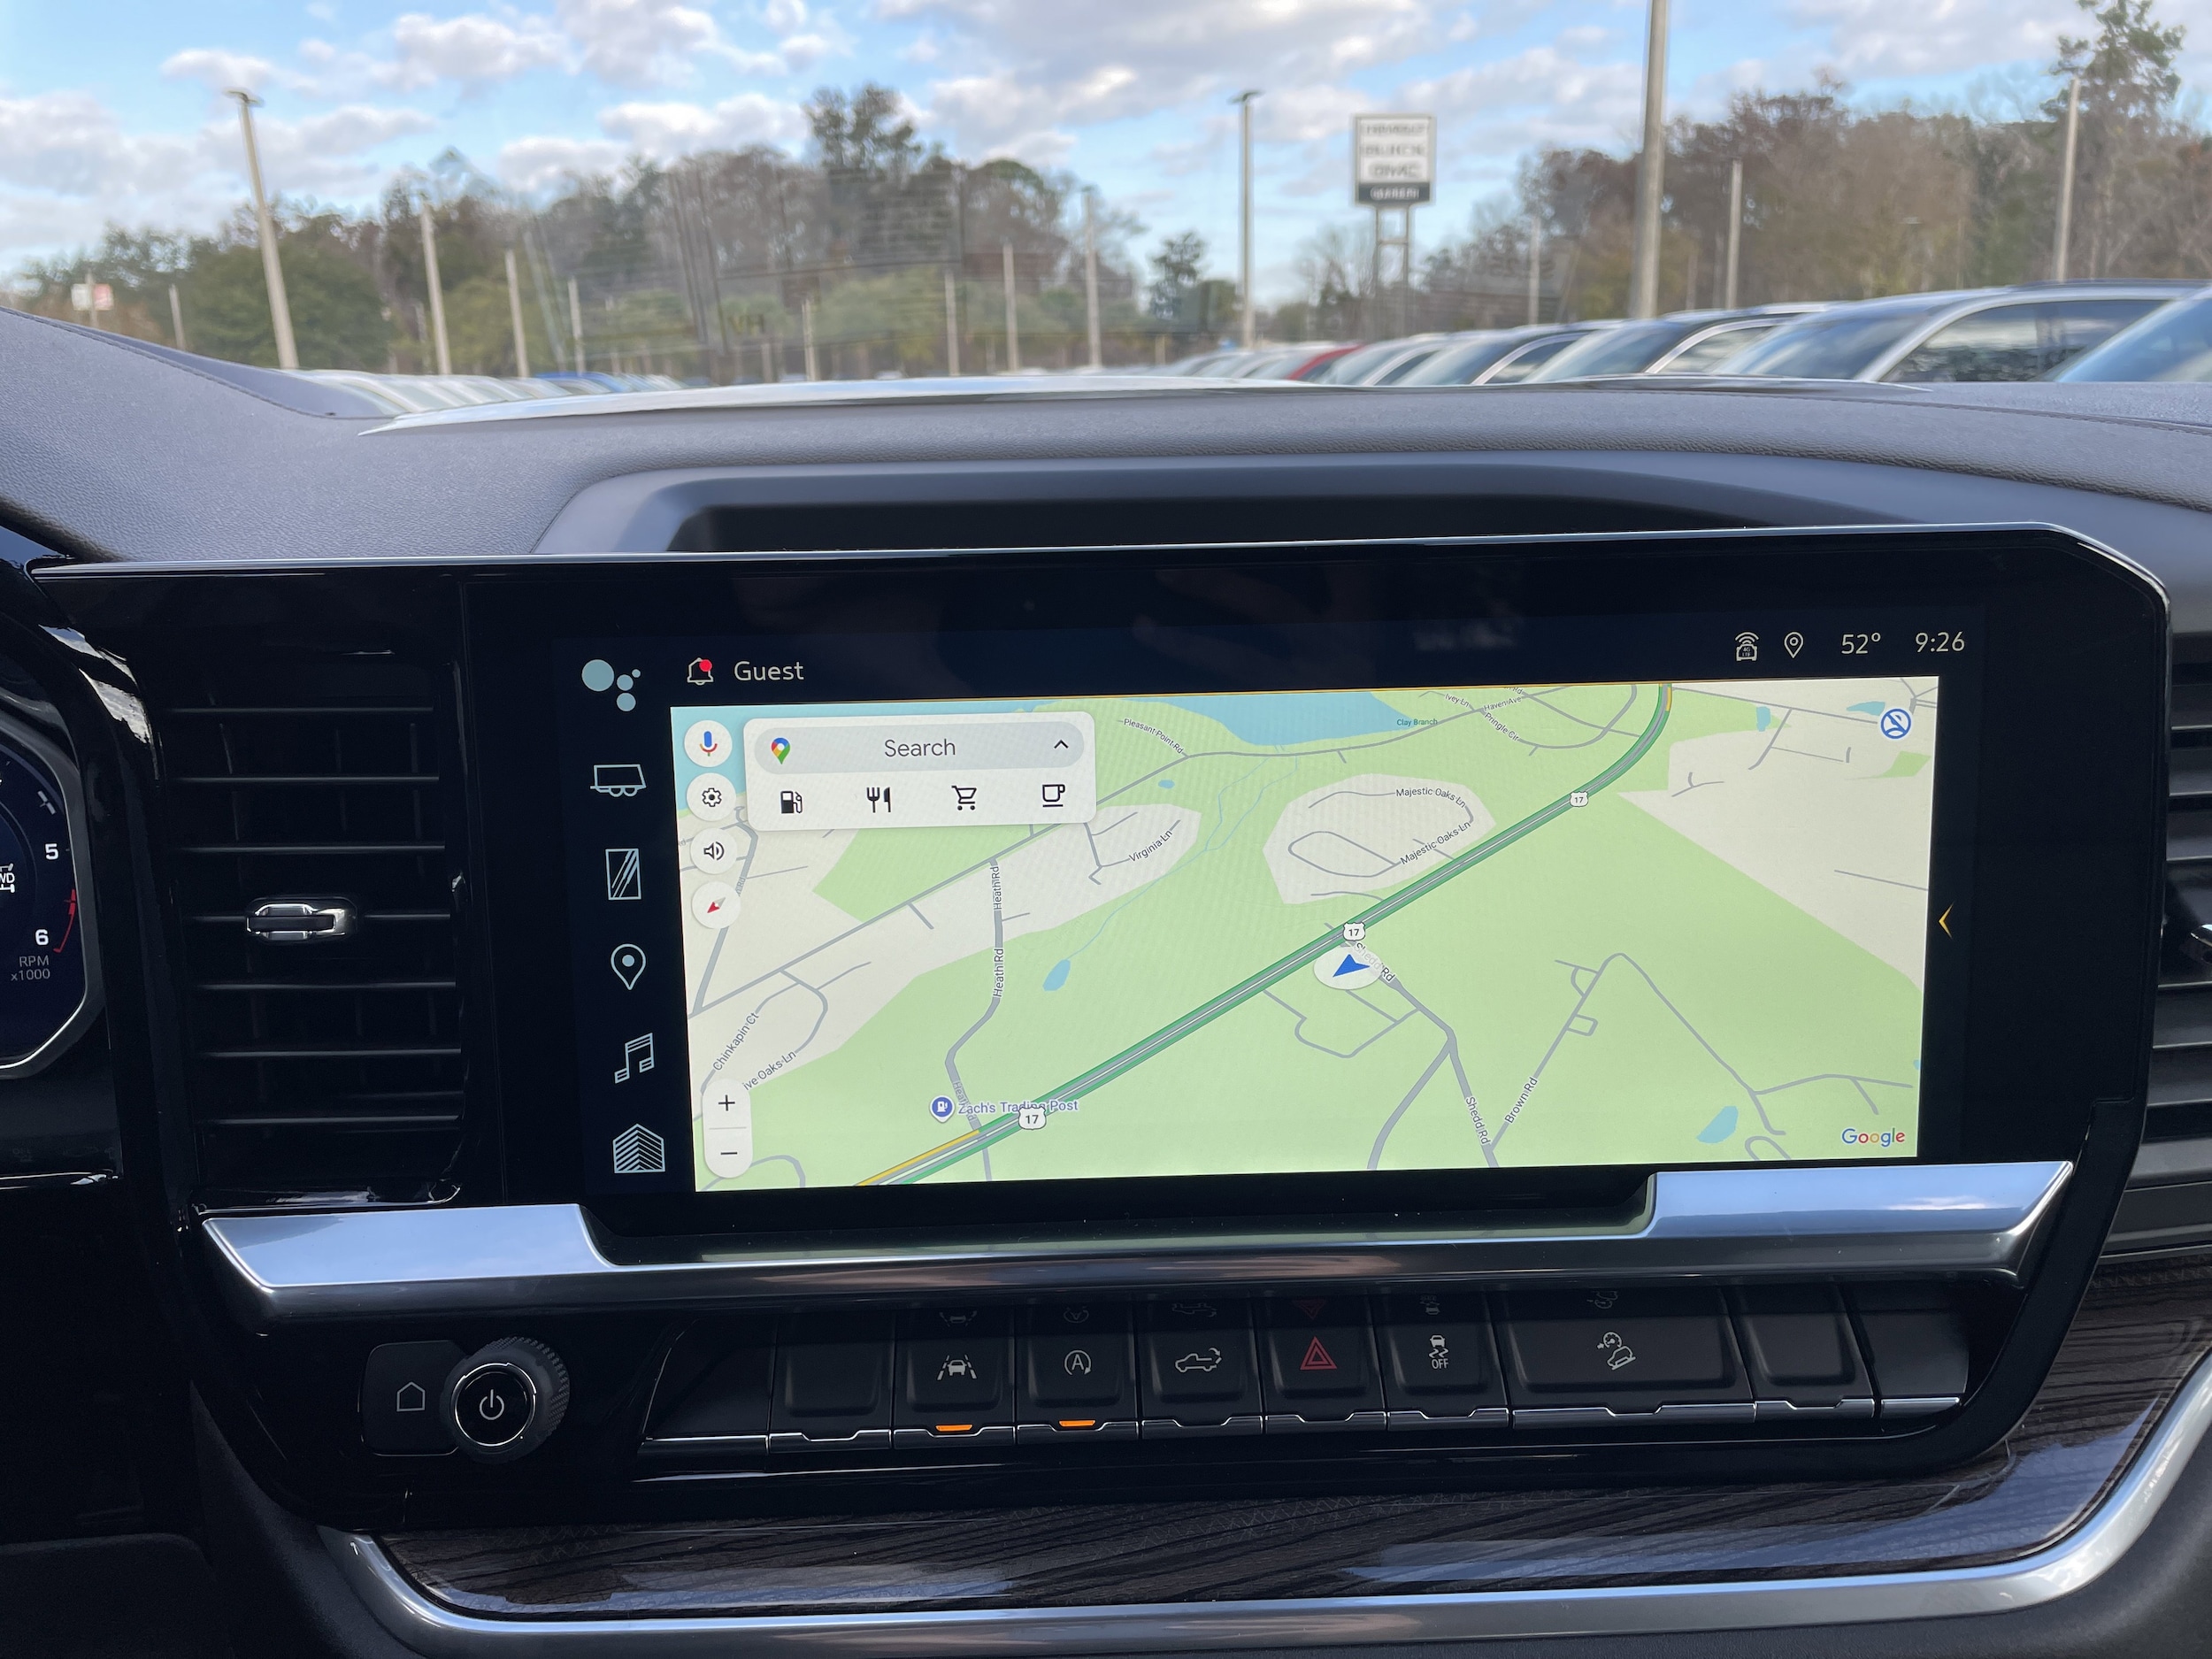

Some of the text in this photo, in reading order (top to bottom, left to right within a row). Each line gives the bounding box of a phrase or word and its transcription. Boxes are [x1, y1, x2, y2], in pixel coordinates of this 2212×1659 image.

[1841, 632, 1881, 655] 52°
[1915, 631, 1965, 653] 9:26
[733, 661, 804, 681] Guest
[1445, 694, 1460, 704] Ivey
[1483, 696, 1522, 711] Haven Ave
[1396, 718, 1412, 727] Clay
[1485, 712, 1509, 733] Pringle
[1124, 718, 1184, 754] Pleasant Point Rd
[884, 739, 956, 757] Search
[1395, 787, 1466, 808] Majestic Oaks Ln
[45, 843, 58, 860] 5
[1128, 830, 1173, 862] Virginia Ln
[1400, 821, 1471, 864] Majestic Oaks Ln
[990, 866, 1002, 910] Heath Rd
[35, 929, 50, 946] 6
[19, 955, 50, 967] RPM
[11, 968, 50, 981] x1000
[993, 949, 1004, 997] Heath Rd
[1381, 967, 1396, 982] Rd
[712, 1012, 759, 1071] Chinkapin Ct
[742, 1051, 797, 1091] ive Oaks Ln
[958, 1102, 996, 1114] Zach's
[1050, 1100, 1079, 1111] Post
[1504, 1076, 1538, 1124] Brown Rd
[1025, 1115, 1039, 1124] 17
[1465, 1096, 1492, 1144] Shedd Rd
[1841, 1127, 1905, 1148] Google
[1431, 1358, 1449, 1369] OFF
